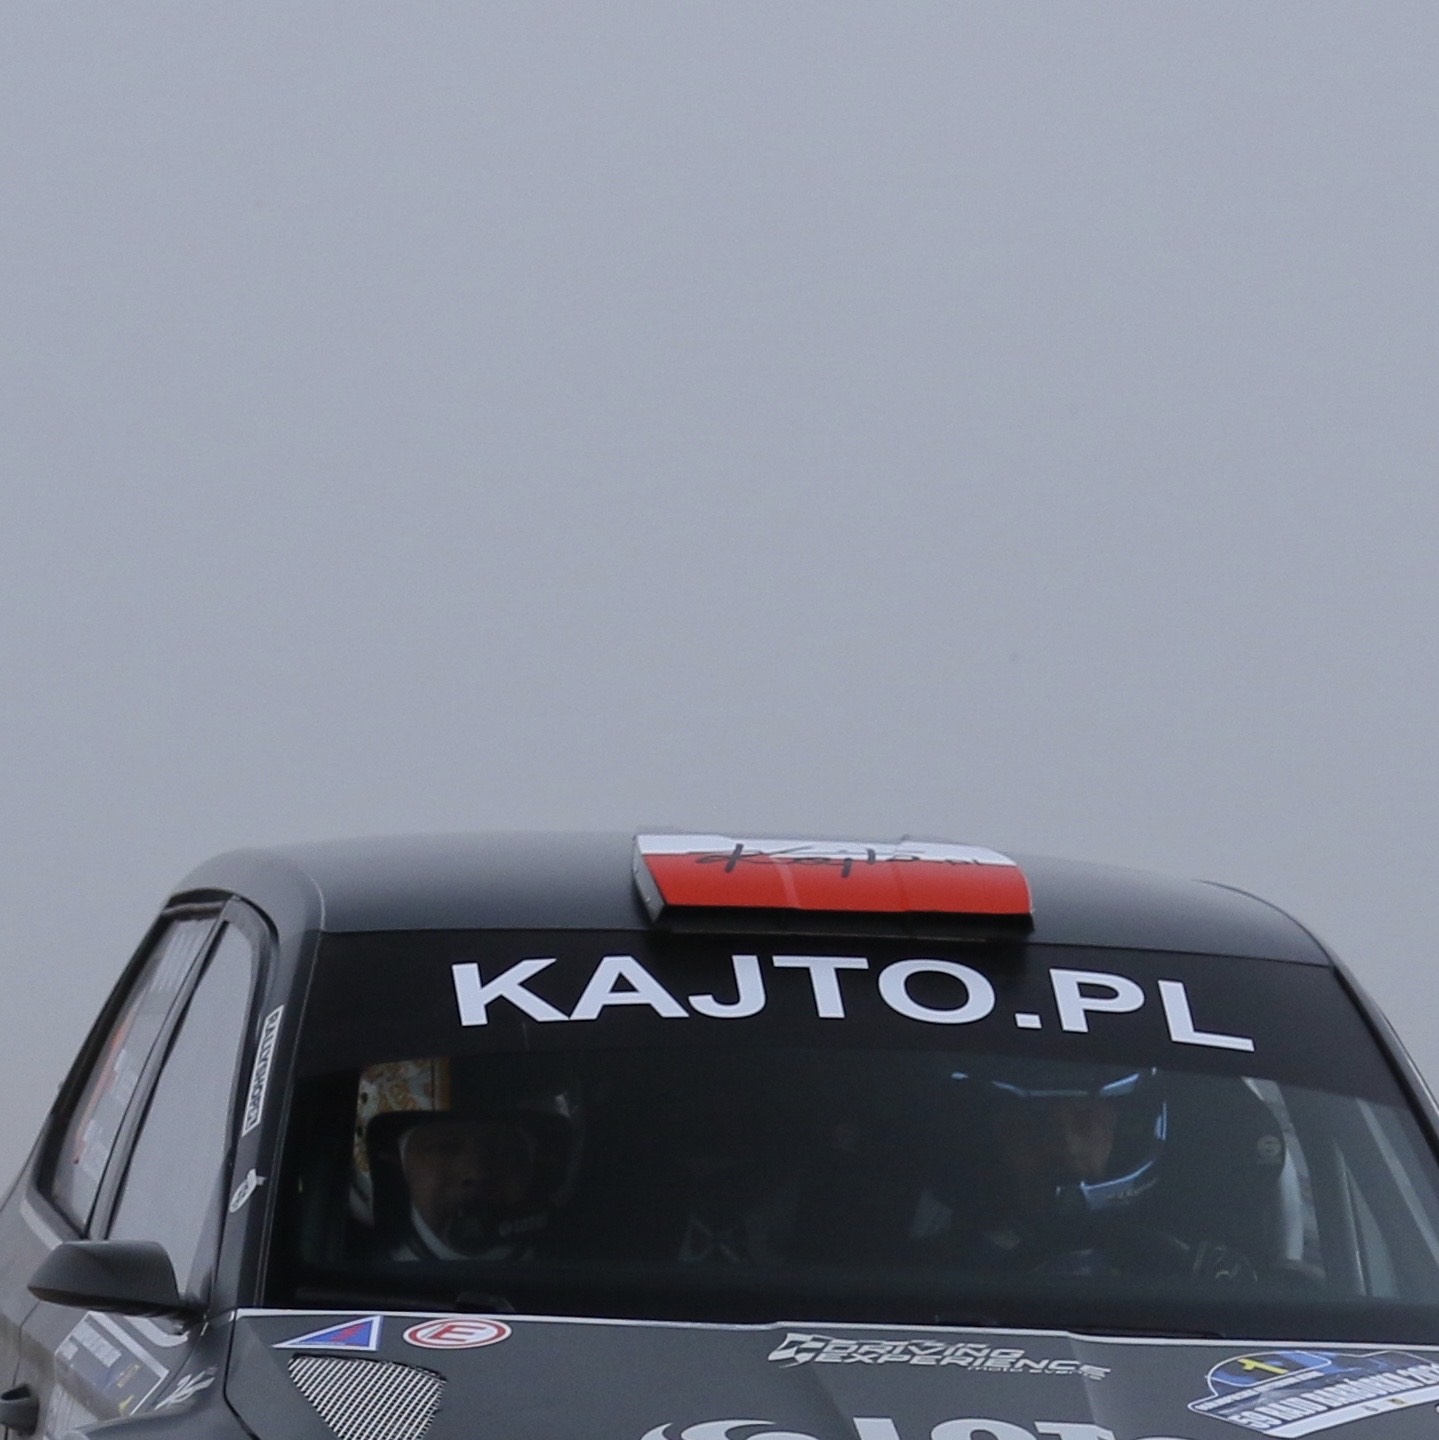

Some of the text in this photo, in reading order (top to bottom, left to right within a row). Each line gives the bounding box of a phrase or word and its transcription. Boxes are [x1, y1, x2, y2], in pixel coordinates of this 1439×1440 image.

[451, 954, 1255, 1053] KAJTO.PL
[821, 1338, 1025, 1358] DRIVING
[815, 1352, 1111, 1379] EXPERIENCE
[1228, 1410, 1283, 1429] 59
